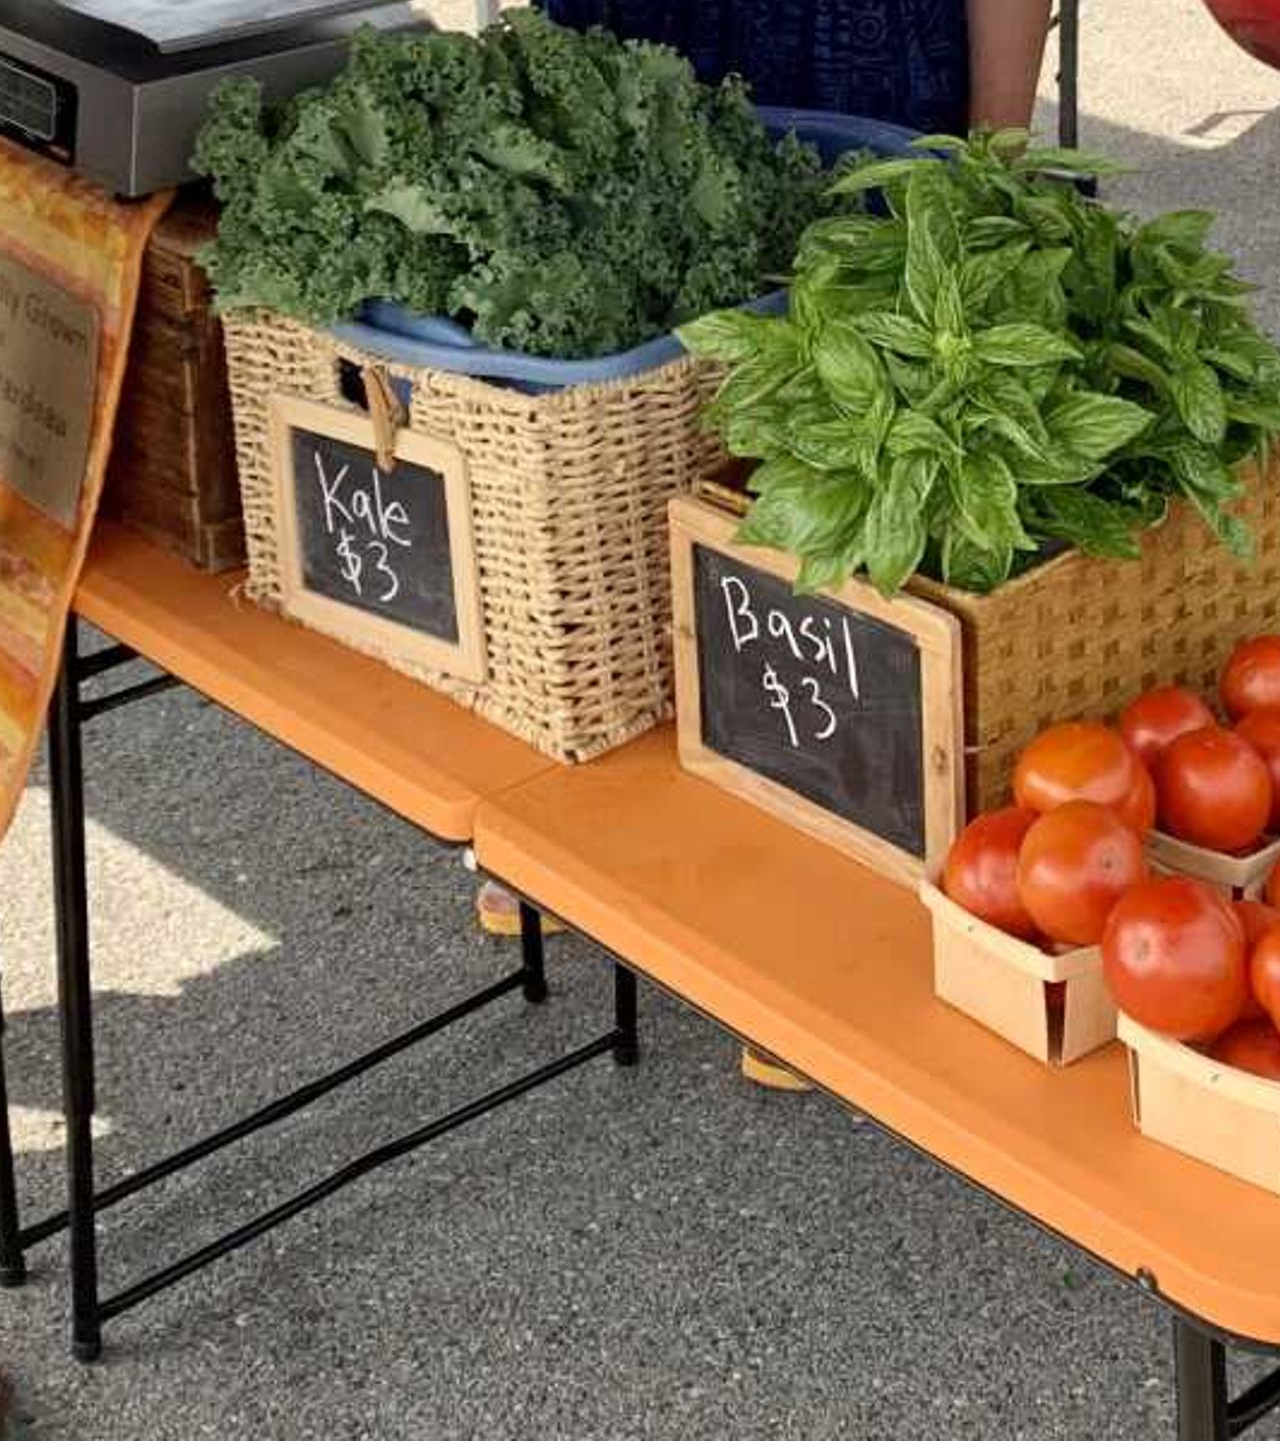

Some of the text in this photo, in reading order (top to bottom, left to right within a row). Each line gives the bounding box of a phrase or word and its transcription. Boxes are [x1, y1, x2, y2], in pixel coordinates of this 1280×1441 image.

[314, 451, 412, 547] Kale
[335, 527, 400, 603] $3
[721, 575, 859, 700] Basil
[762, 661, 837, 747] $3
